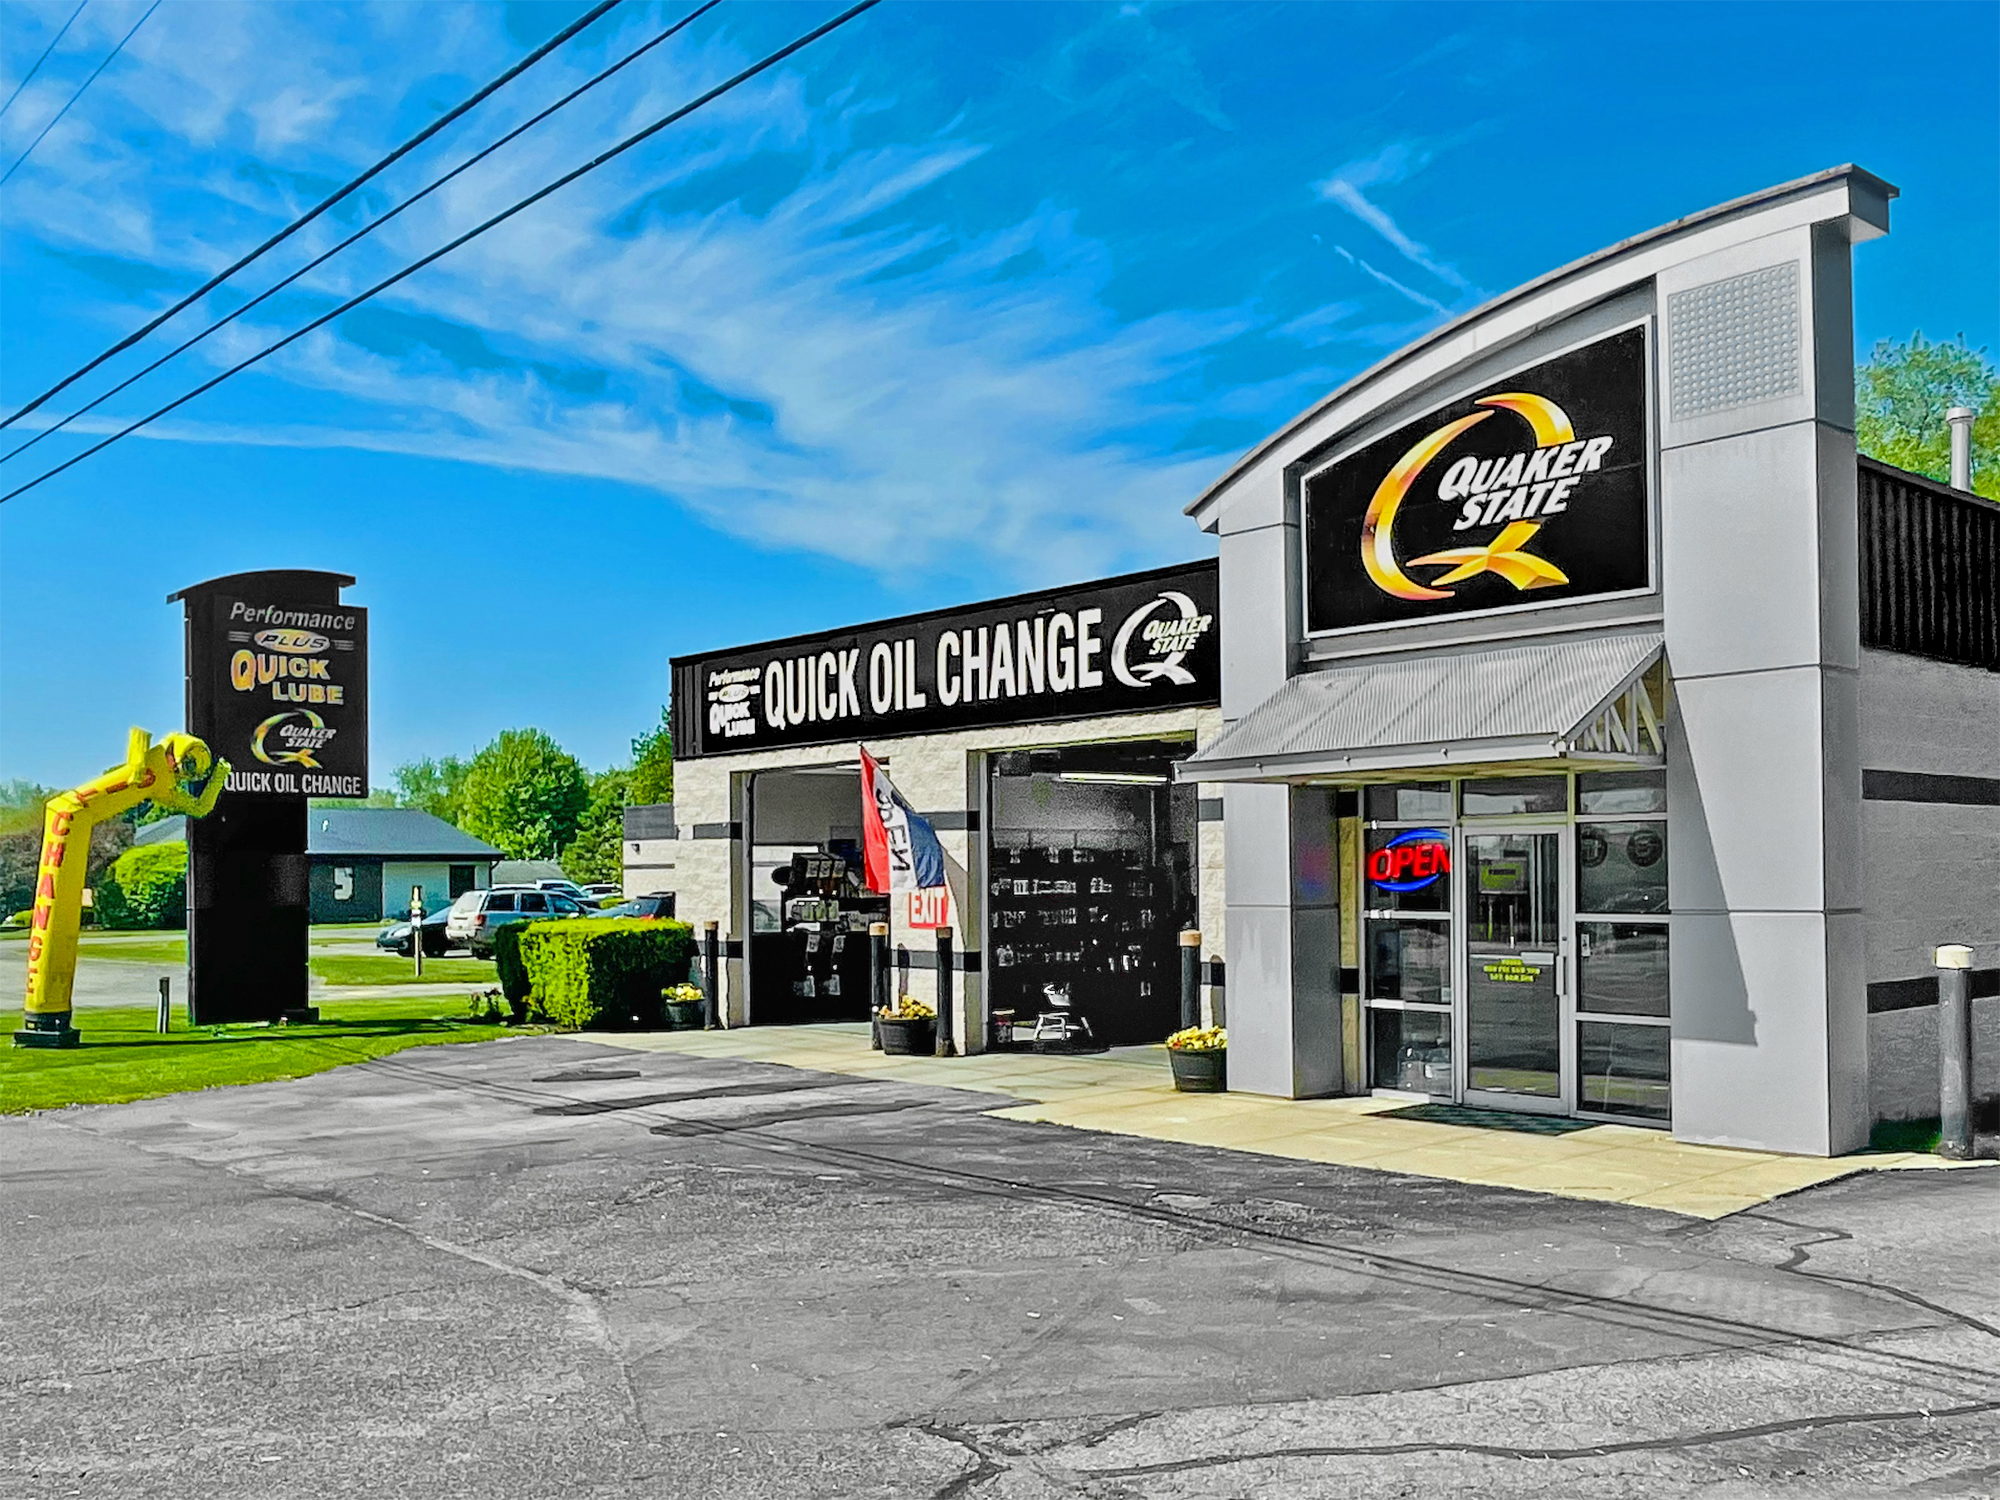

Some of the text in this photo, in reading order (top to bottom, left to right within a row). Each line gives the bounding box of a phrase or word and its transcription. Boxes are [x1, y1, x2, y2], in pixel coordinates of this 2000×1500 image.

[1438, 436, 1613, 501] QUAKER
[1453, 476, 1580, 530] STATE
[229, 602, 355, 630] Performance
[1142, 614, 1213, 641] QUAKER
[261, 634, 327, 649] PLUS
[1148, 633, 1200, 655] STATE
[231, 649, 331, 691] QUICK
[764, 608, 1103, 731] QUICK OIL CHANGE
[272, 681, 344, 705] LUBE
[279, 724, 337, 739] QUAKER
[285, 737, 327, 748] STATE
[224, 771, 361, 795] QUICK OIL CHANGE
[1368, 843, 1452, 880] OPEN
[911, 888, 946, 923] EXIT
